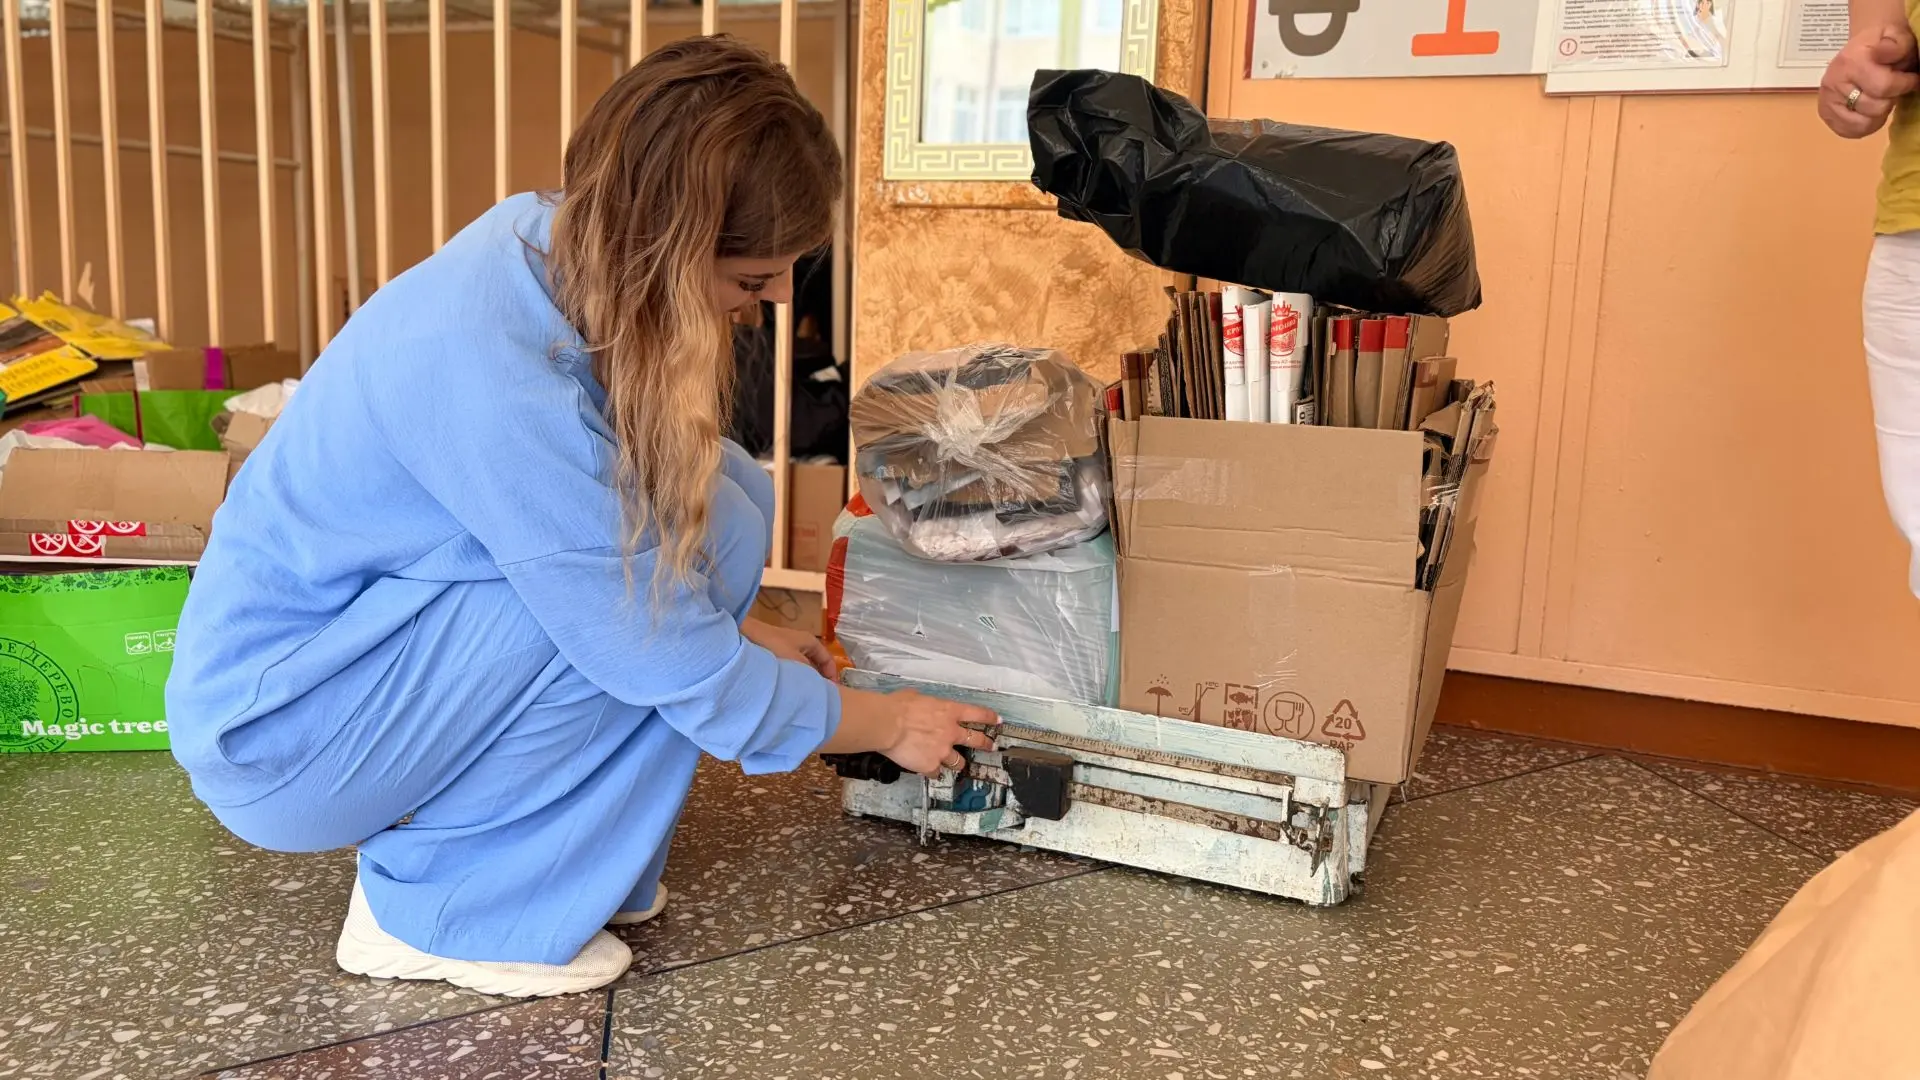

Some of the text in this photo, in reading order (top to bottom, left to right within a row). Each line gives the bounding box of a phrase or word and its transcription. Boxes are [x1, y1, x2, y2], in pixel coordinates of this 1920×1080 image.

[23, 652, 74, 718] ДЕРЕВО
[21, 718, 168, 739] Magic tree
[1335, 717, 1352, 729] 20
[1329, 739, 1355, 751] PAP
